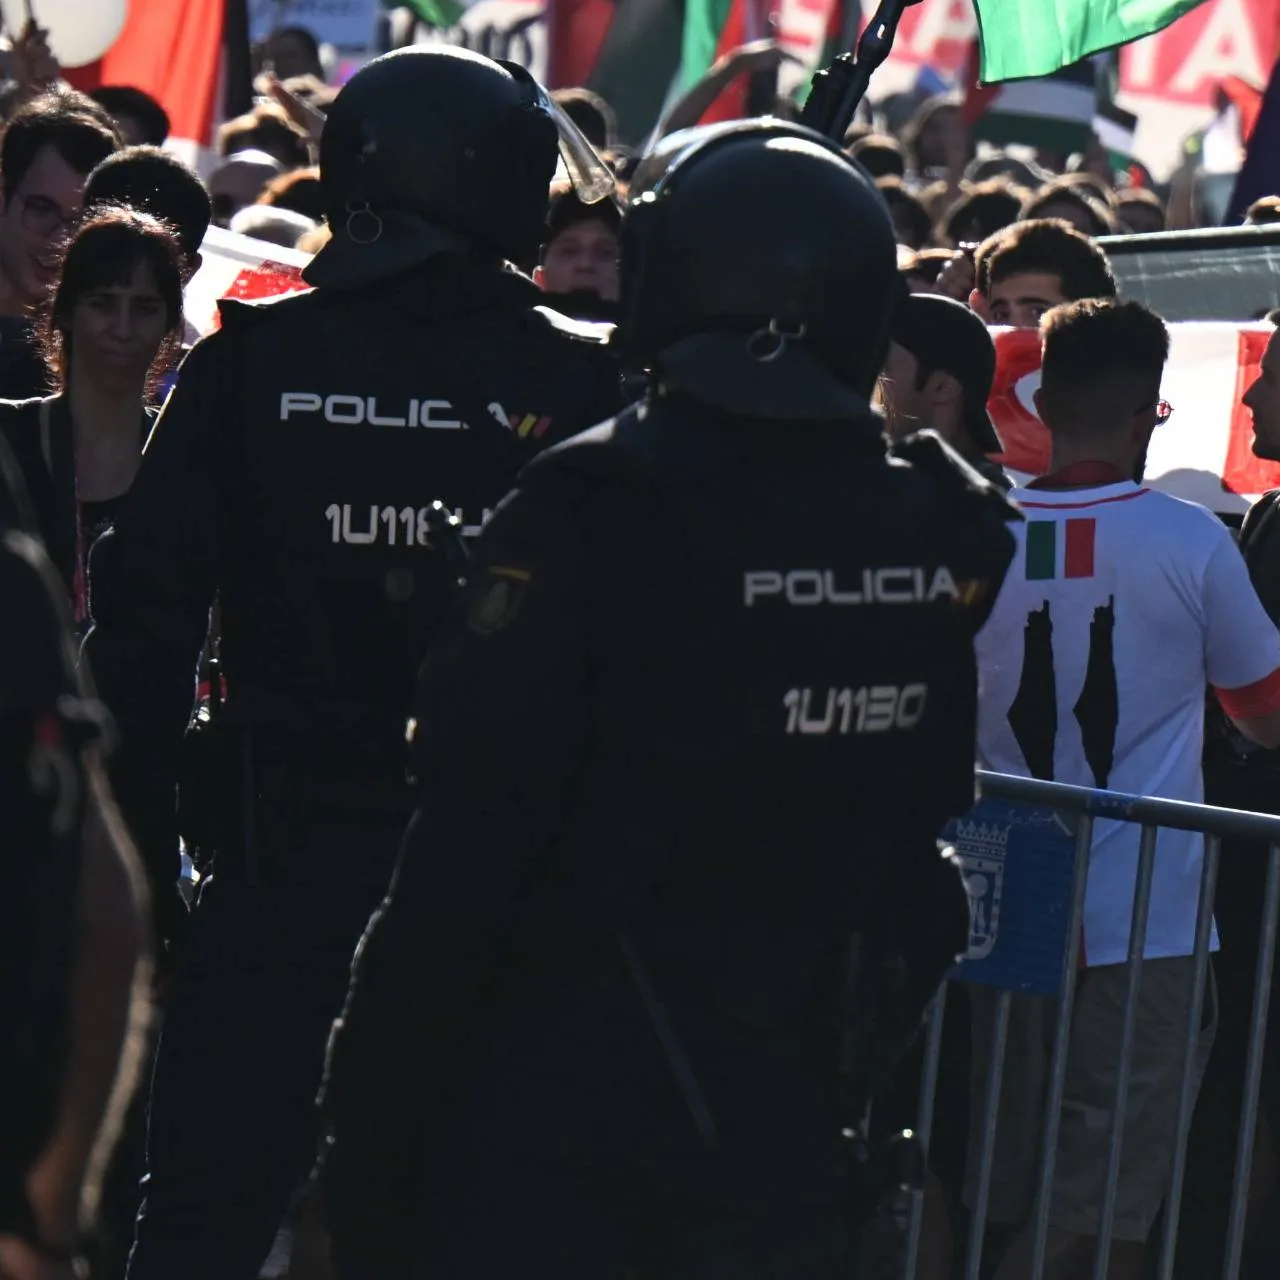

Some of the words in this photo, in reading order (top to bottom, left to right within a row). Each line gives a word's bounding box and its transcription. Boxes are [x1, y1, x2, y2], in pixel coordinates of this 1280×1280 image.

[280, 392, 513, 431] POLICA
[744, 567, 960, 606] POLICIA
[783, 682, 928, 734] 1U1130
